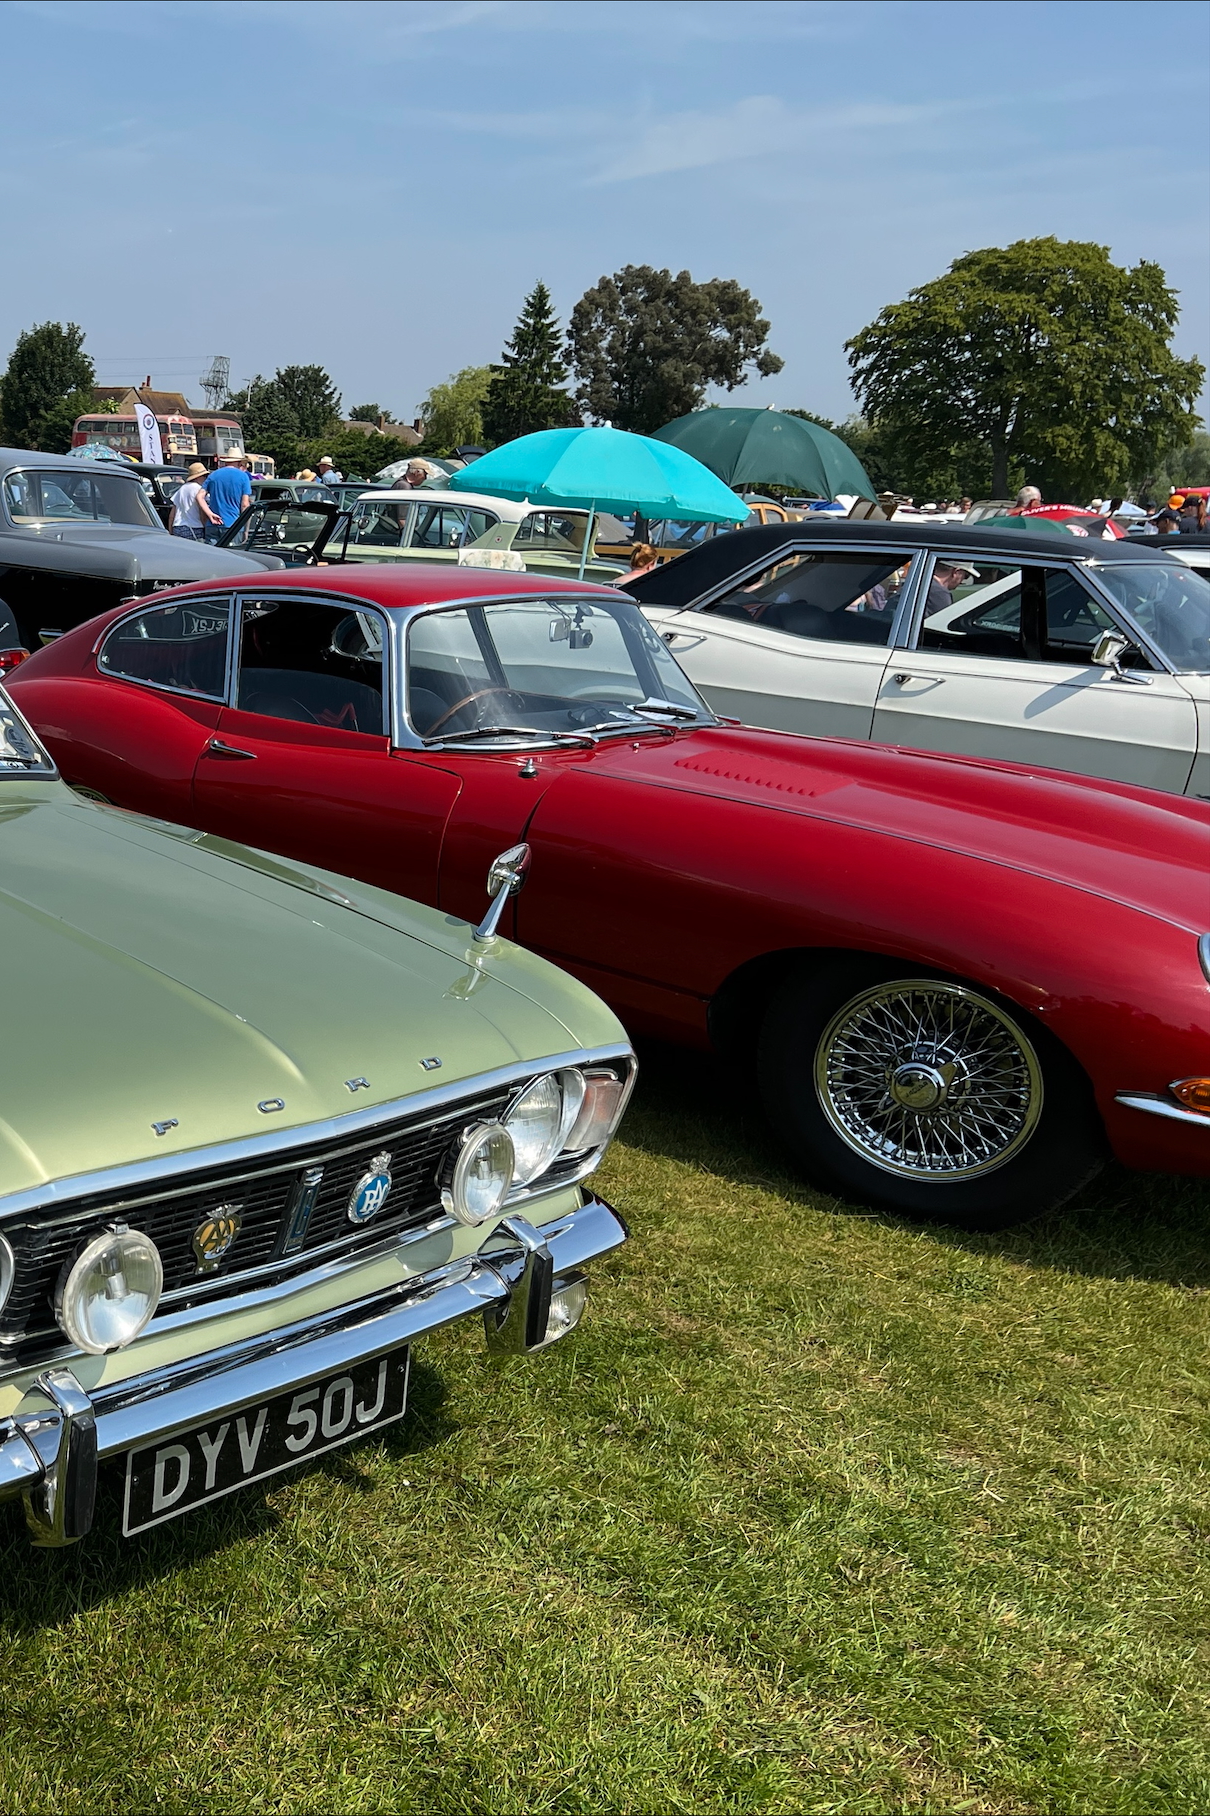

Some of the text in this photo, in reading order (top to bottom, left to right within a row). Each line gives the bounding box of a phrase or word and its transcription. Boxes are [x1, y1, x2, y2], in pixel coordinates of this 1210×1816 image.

[1059, 504, 1088, 514] MOUNT
[151, 1056, 443, 1137] FORD
[152, 1360, 388, 1513] DYV 50J
